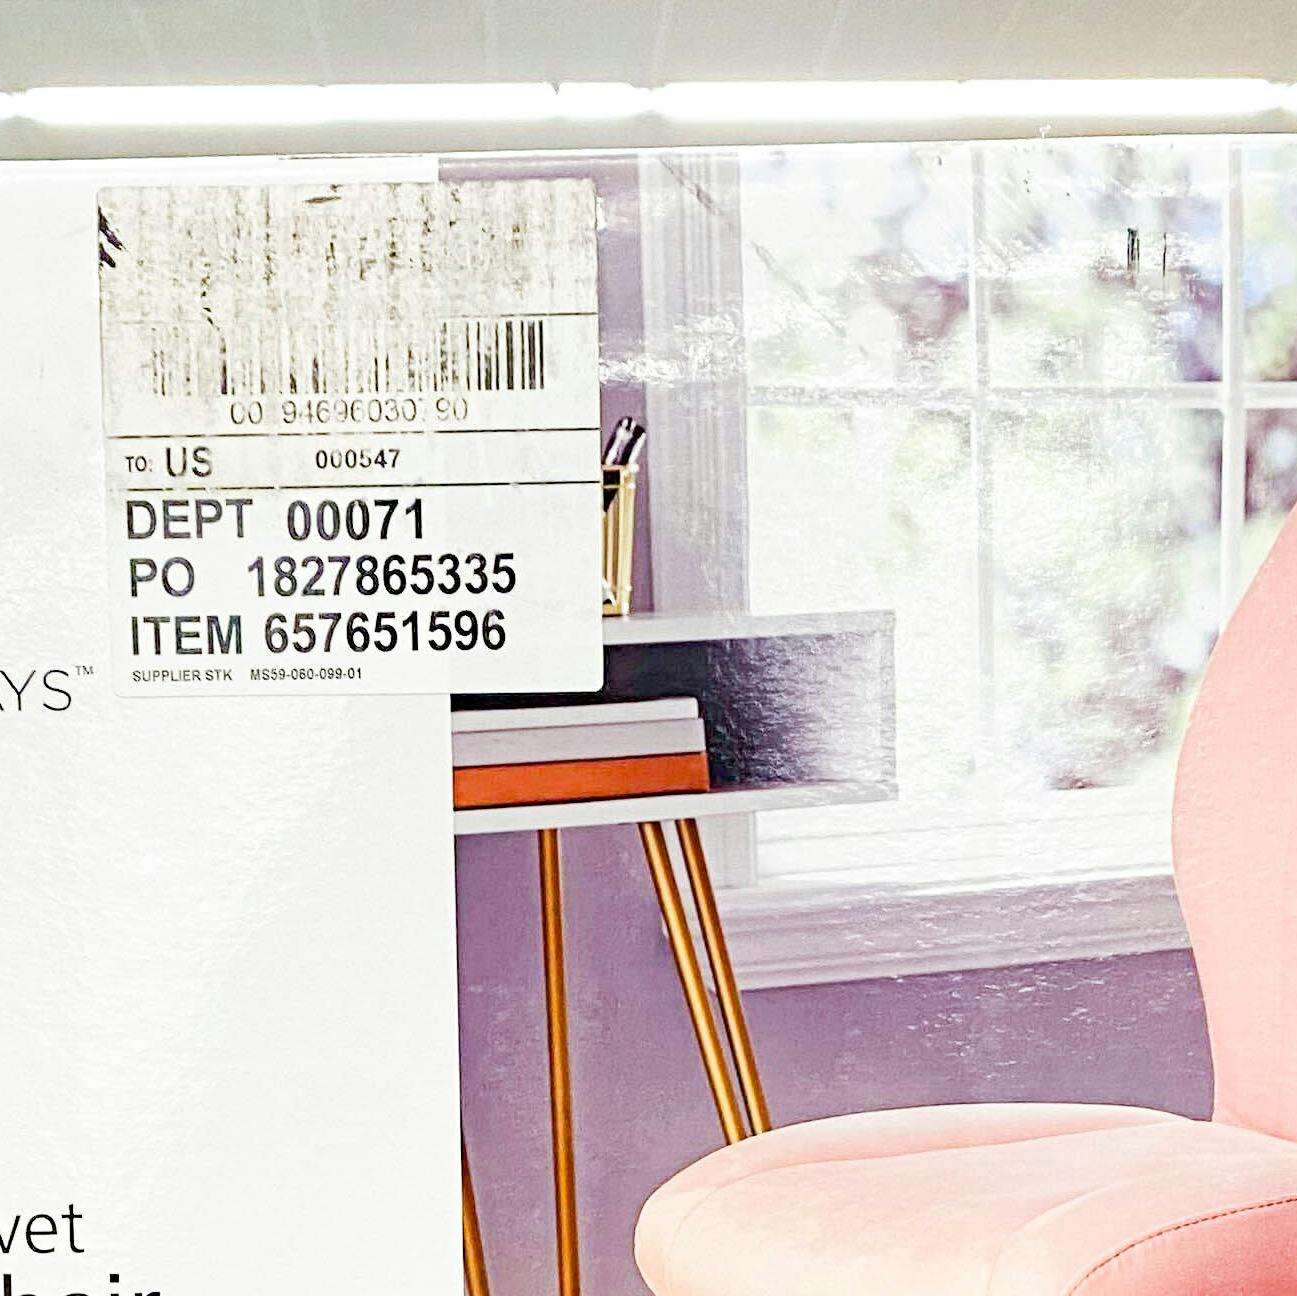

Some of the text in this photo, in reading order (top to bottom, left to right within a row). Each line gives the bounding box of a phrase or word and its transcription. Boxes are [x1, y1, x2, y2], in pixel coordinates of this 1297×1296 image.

[165, 446, 212, 478] US
[315, 448, 401, 470] 000547
[126, 498, 423, 542] DEPT 00071
[129, 552, 516, 598] PO 1827865335
[131, 608, 506, 656] ITEM 657651596
[132, 669, 202, 683] SUPPLIER
[204, 668, 233, 682] STK
